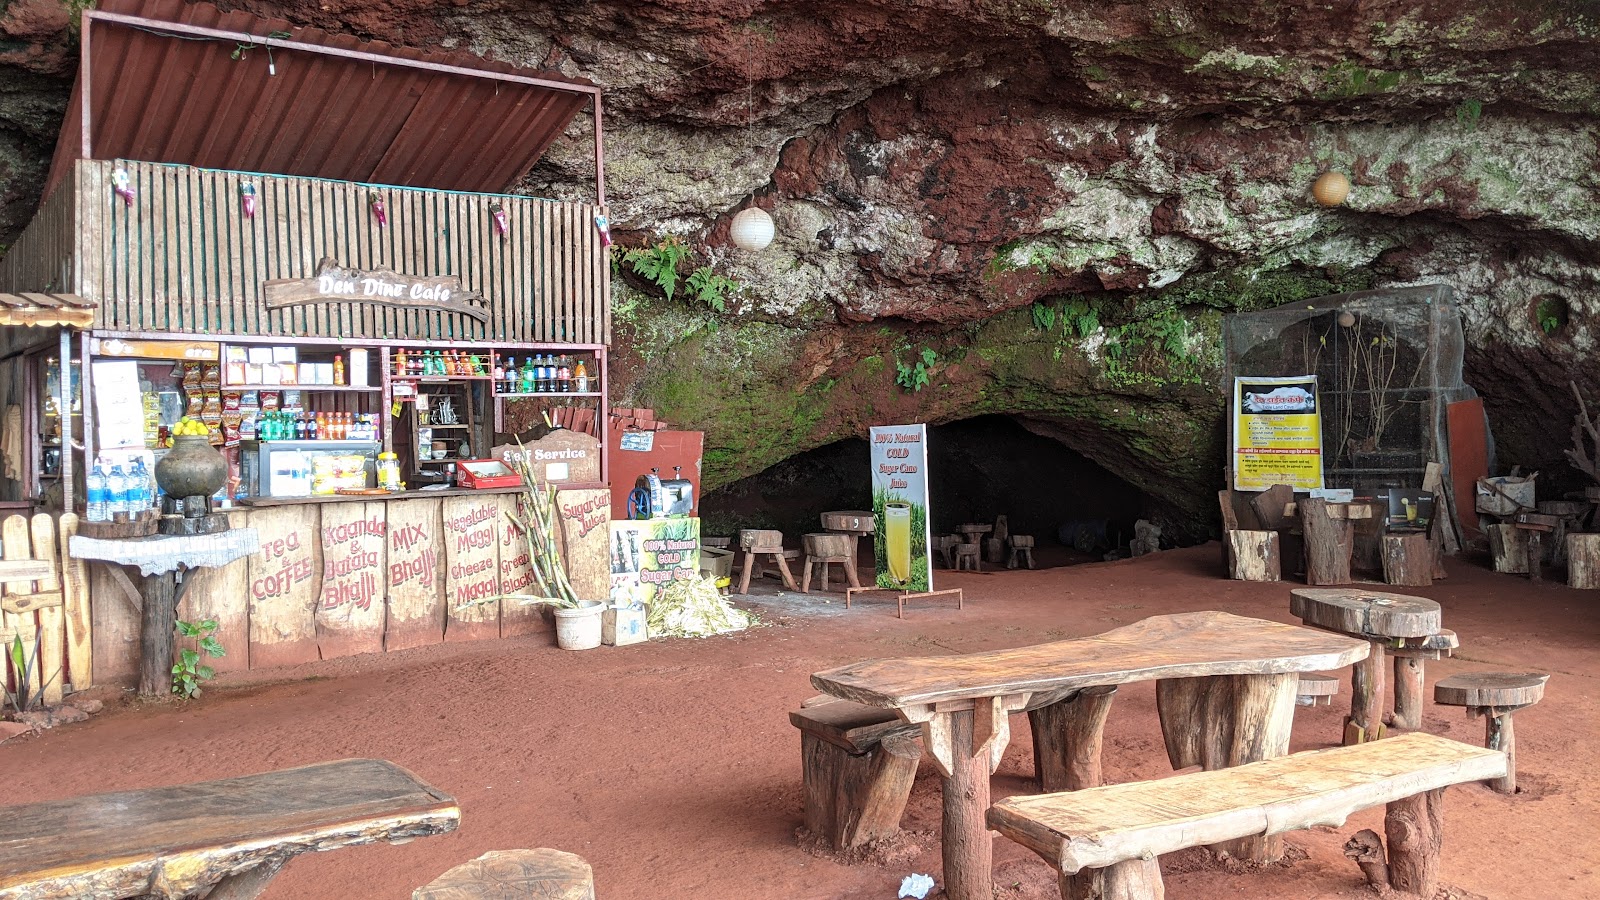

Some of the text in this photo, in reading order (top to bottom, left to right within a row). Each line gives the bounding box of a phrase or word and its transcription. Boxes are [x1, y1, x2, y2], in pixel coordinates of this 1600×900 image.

[319, 275, 451, 301] Den Dine Cafe
[894, 431, 921, 443] Natural
[534, 447, 586, 460] Service
[886, 448, 909, 458] COLD
[889, 478, 907, 489] Juice
[563, 500, 593, 522] Sugar
[1520, 514, 1527, 523] 11
[325, 515, 386, 546] Kaanda
[579, 513, 606, 538] Juice
[853, 518, 859, 528] 9
[262, 531, 300, 562] Tea
[351, 540, 363, 554] &
[643, 537, 697, 551] 100% Natural
[282, 556, 291, 568] &
[325, 551, 378, 580] Batata
[502, 553, 530, 576] Green
[657, 552, 681, 564] COLD
[253, 556, 312, 600] COFFEE
[502, 572, 534, 594] Black
[640, 568, 673, 584] Sugar
